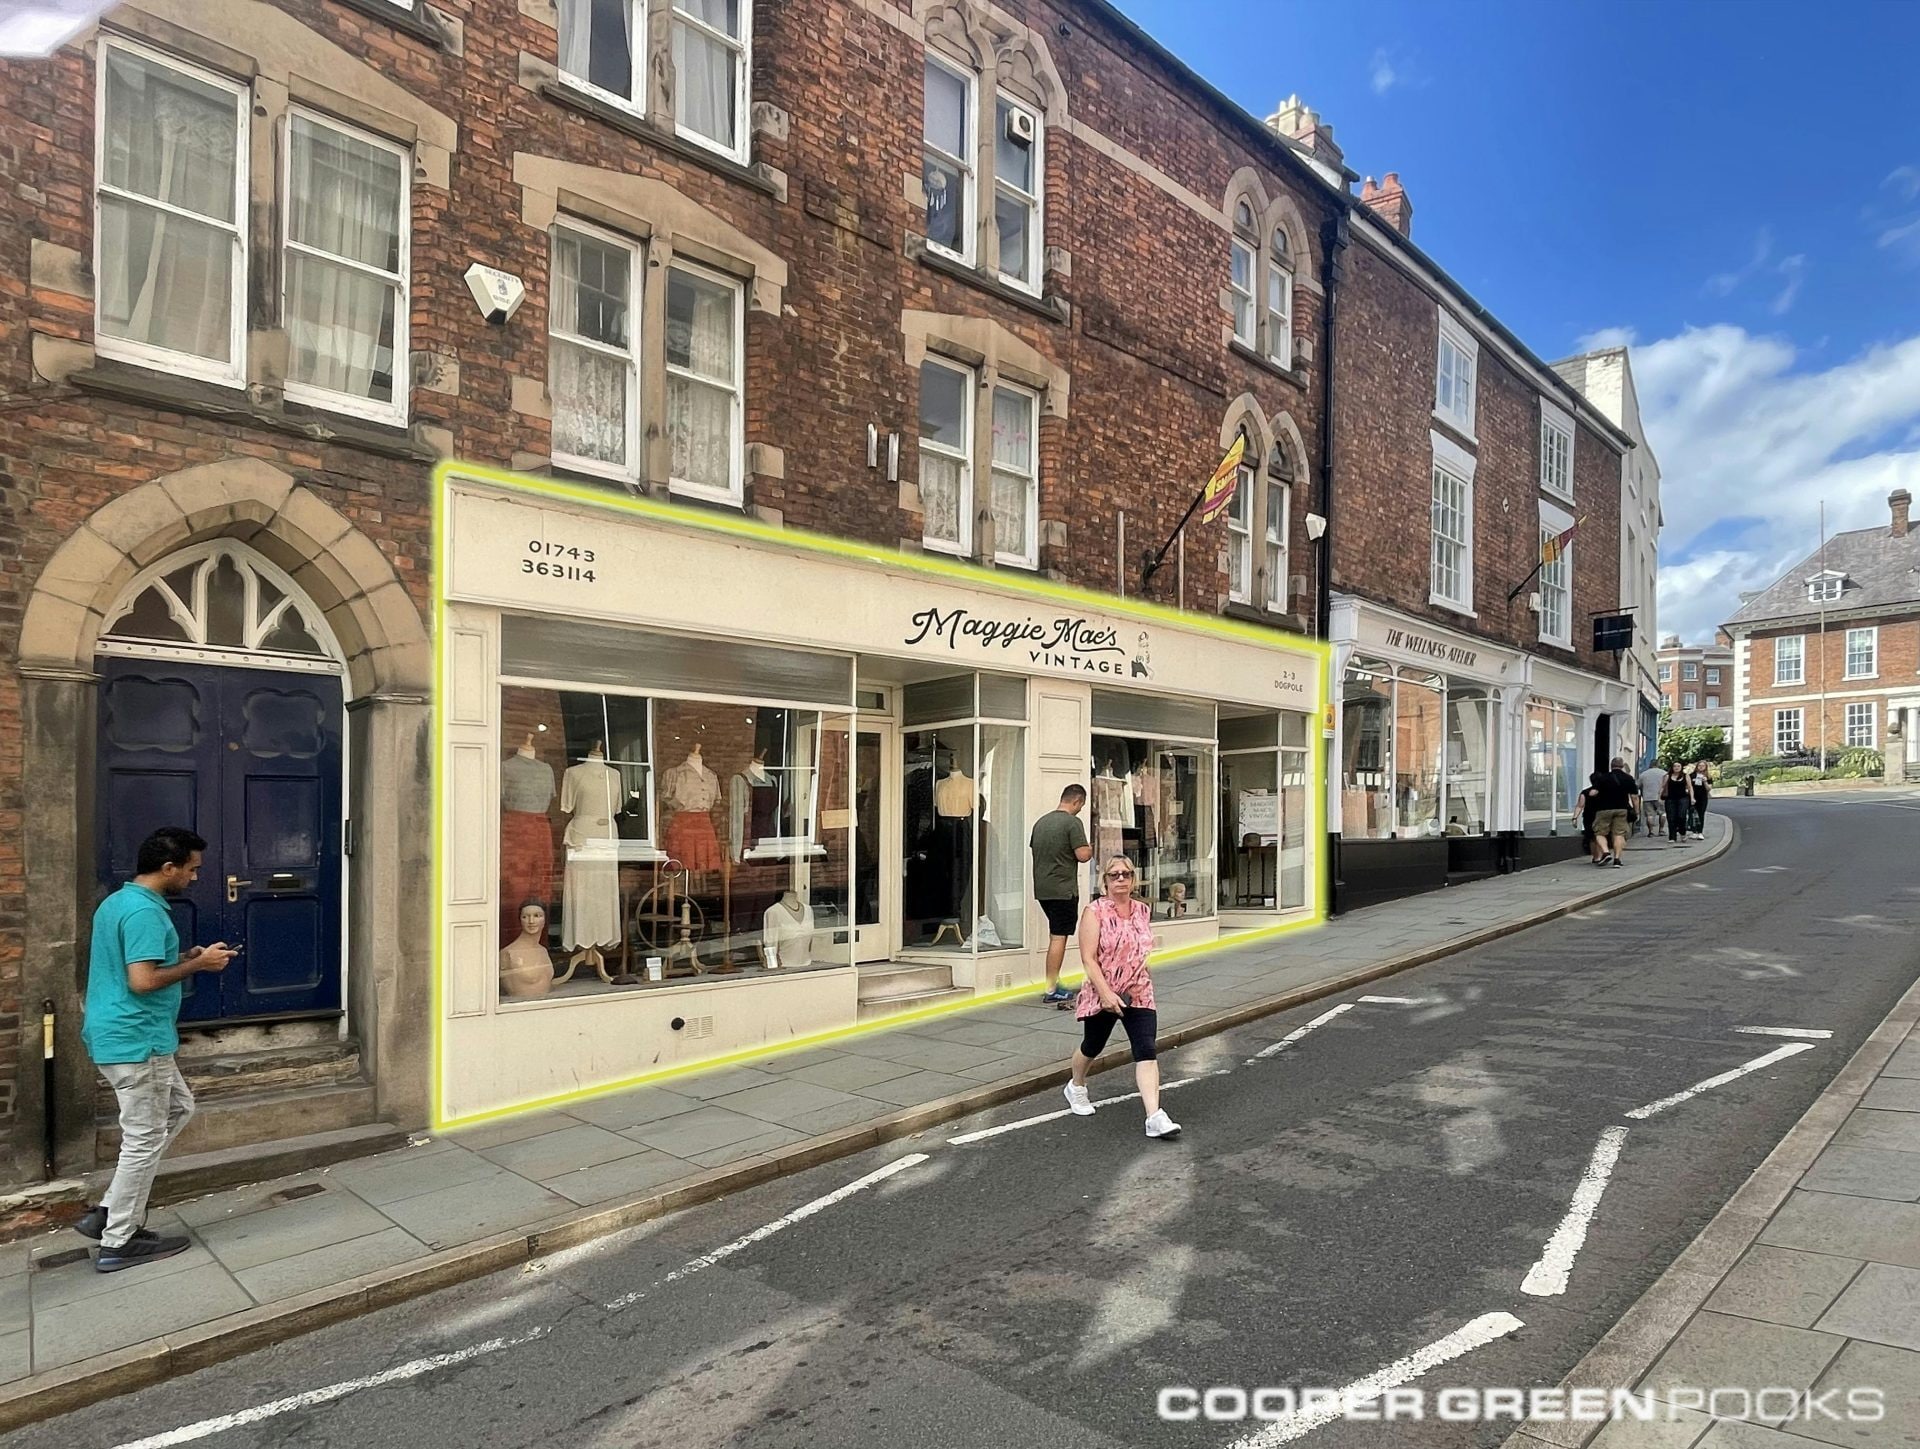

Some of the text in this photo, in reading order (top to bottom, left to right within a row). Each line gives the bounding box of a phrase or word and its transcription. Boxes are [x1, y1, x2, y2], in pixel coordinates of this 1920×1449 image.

[529, 540, 595, 562] 01743
[522, 559, 596, 583] 363114
[905, 608, 1125, 656] Maggie Mae's
[1385, 628, 1404, 648] THE
[1405, 633, 1447, 659] WELLNESS
[1029, 651, 1123, 675] VINTAGE
[1283, 670, 1296, 680] 2-3
[1274, 680, 1304, 693] DOGPOLE
